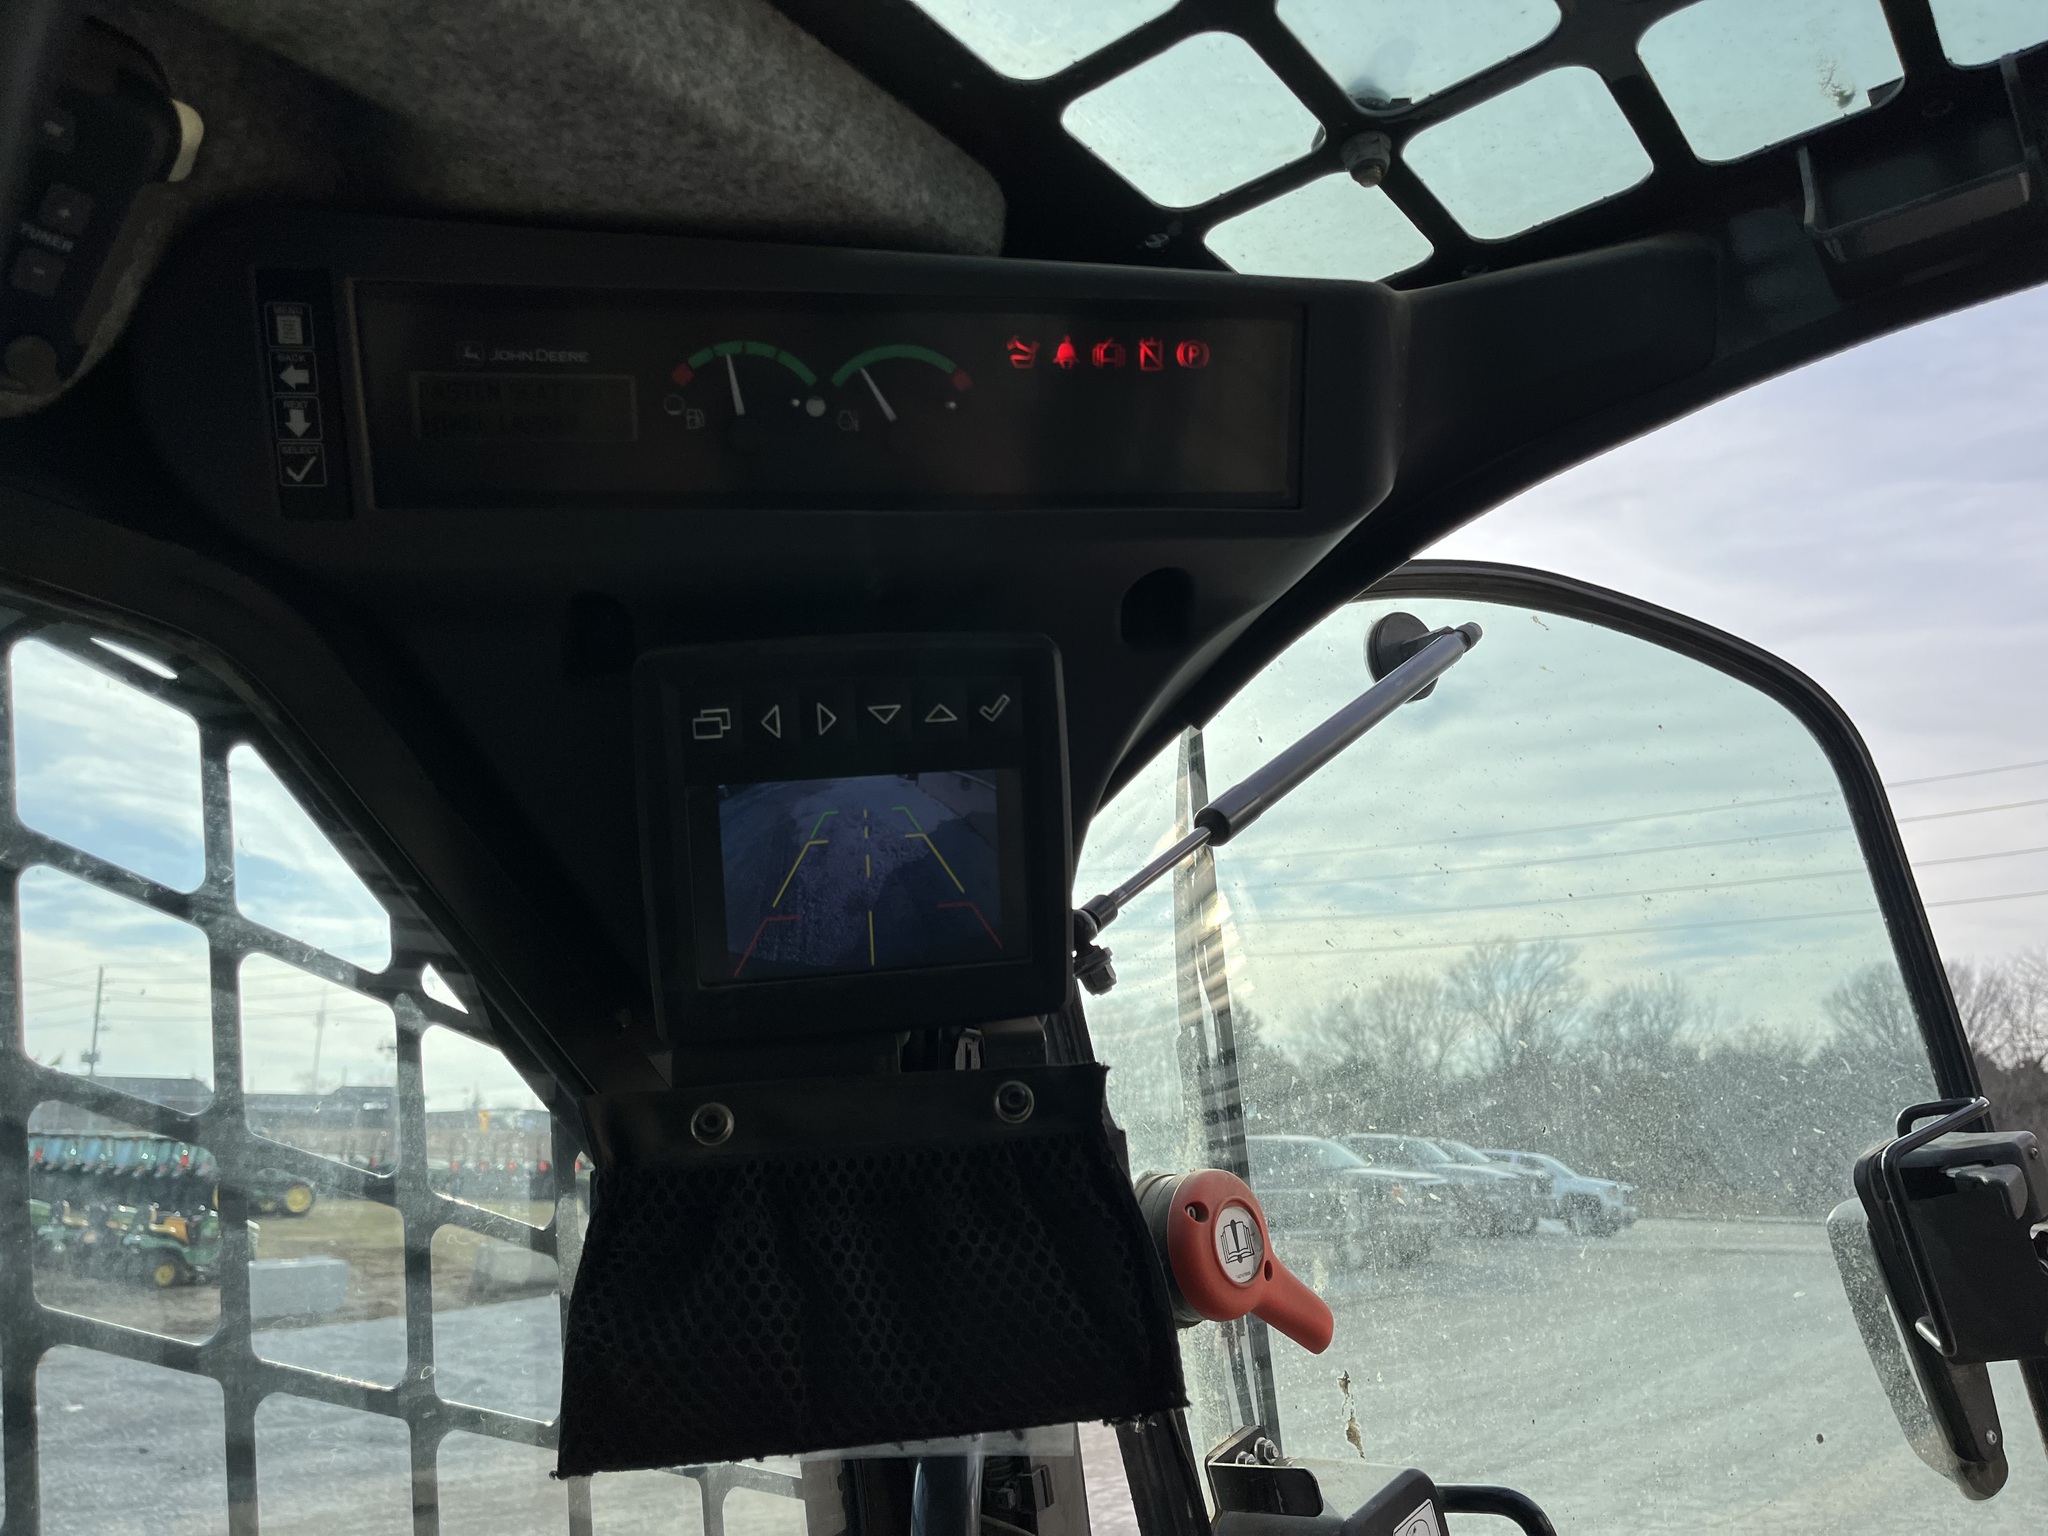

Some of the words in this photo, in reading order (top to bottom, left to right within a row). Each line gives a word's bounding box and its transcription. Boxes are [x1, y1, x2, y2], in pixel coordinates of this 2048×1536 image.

[273, 305, 303, 315] MENU
[276, 353, 306, 362] BACK
[490, 347, 533, 362] JOHN
[535, 347, 590, 363] DEERE
[282, 400, 308, 409] NEXT
[281, 446, 319, 455] SELECT
